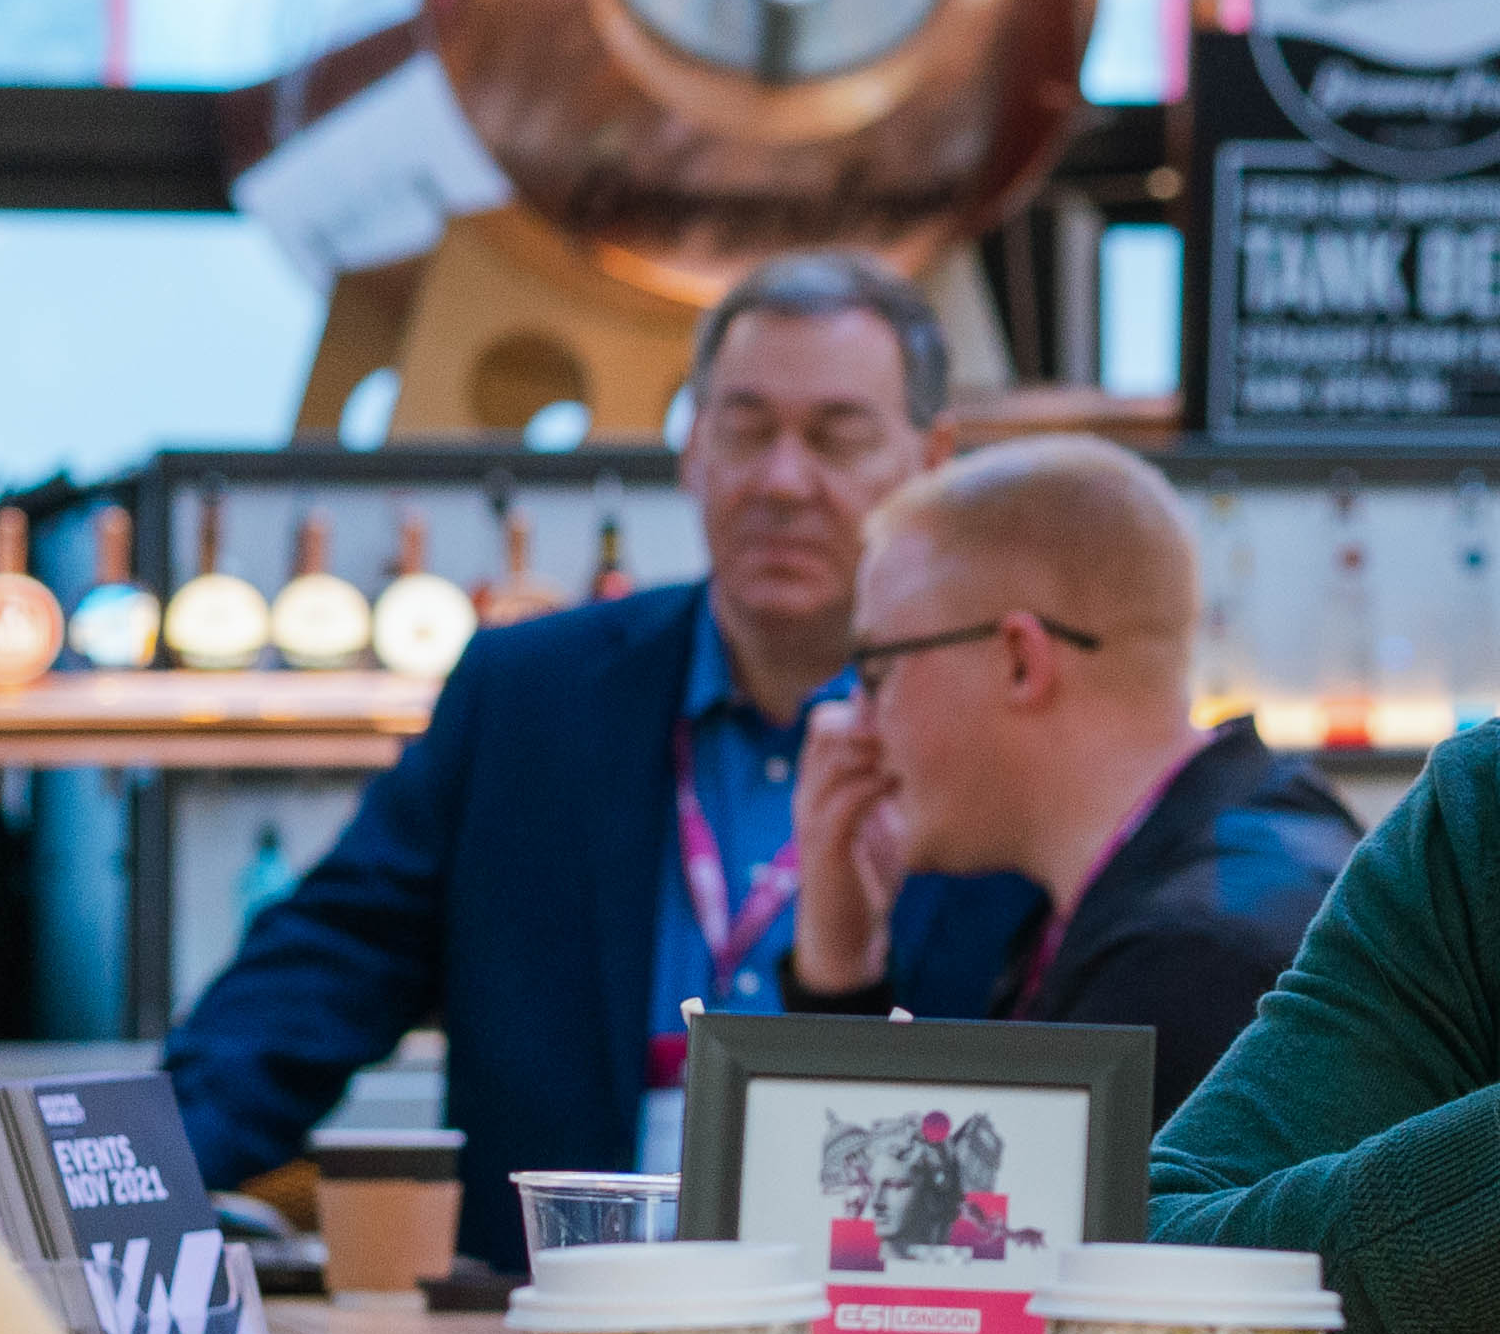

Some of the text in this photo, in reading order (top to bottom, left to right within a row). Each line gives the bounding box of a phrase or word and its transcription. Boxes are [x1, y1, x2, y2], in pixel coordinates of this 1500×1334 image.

[1242, 224, 1408, 317] TANK
[52, 1134, 138, 1174] EVENTS
[64, 1165, 170, 1211] NOV 2021
